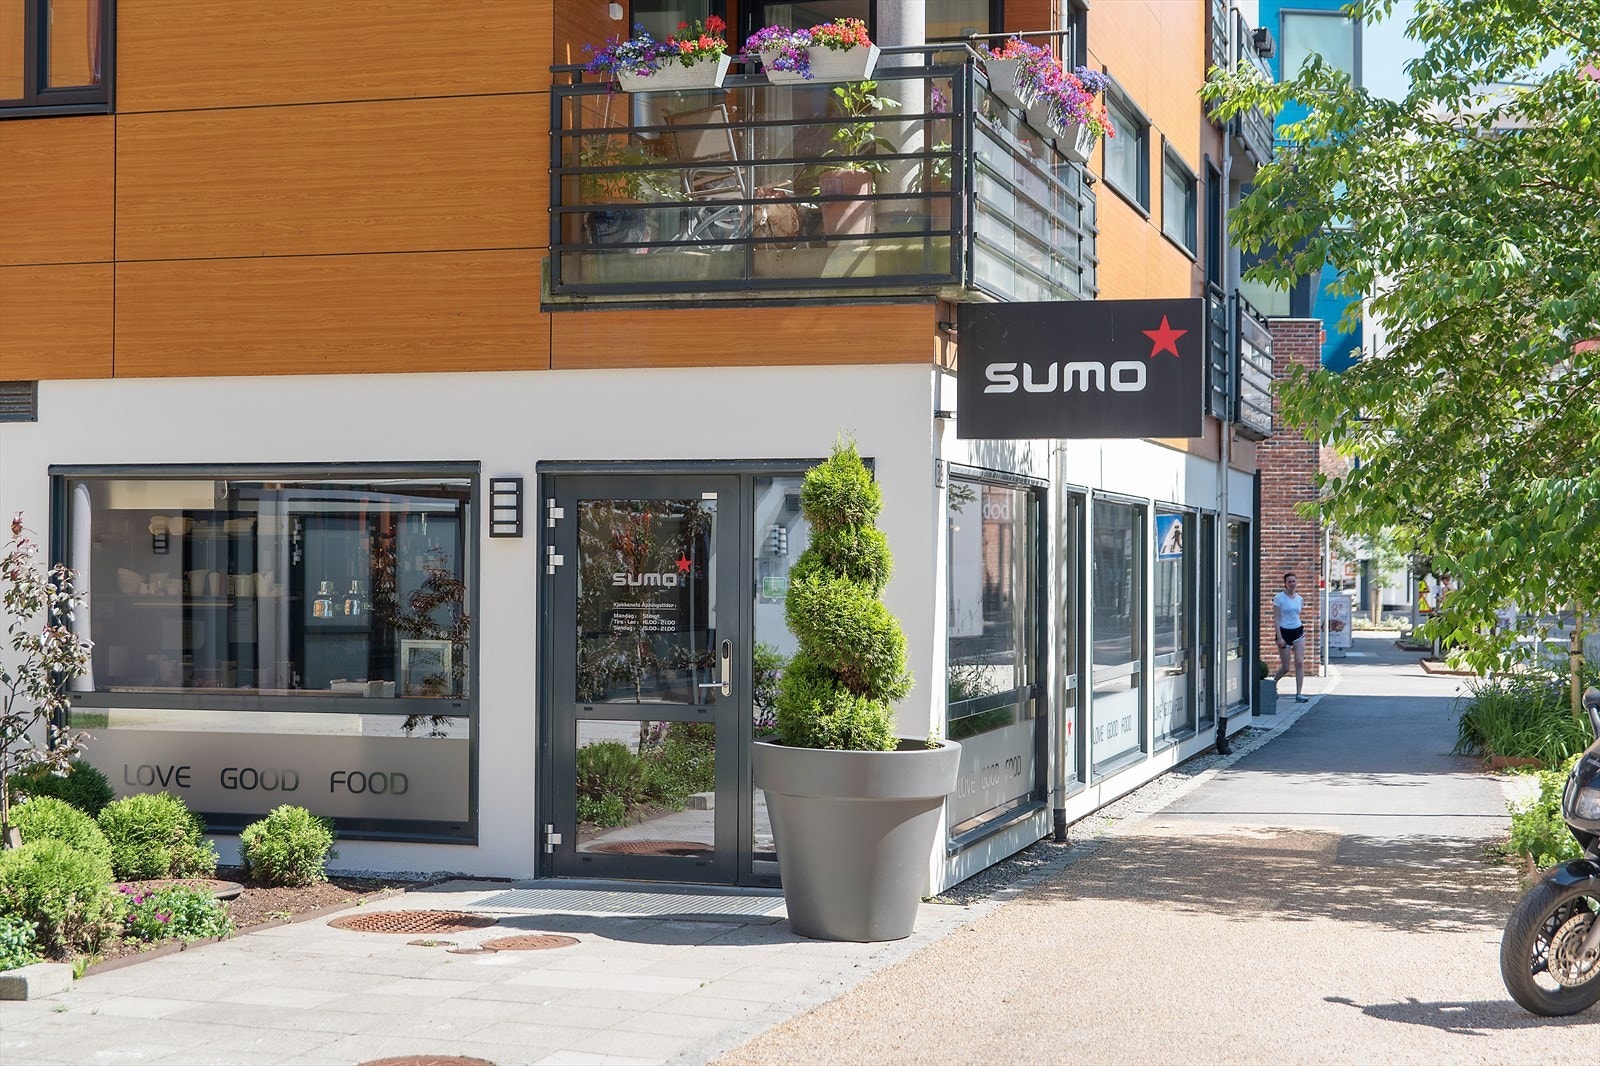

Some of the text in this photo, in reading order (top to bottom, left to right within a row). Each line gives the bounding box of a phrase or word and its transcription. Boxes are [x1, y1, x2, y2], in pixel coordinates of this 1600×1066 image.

[983, 360, 1147, 394] SUMO
[612, 572, 678, 587] SUMO
[1106, 720, 1118, 740] GOOD
[1121, 714, 1132, 734] FOOD
[123, 763, 409, 796] LOVE GOOD FOOD
[957, 755, 1022, 799] LOVE GOOD FOOD
